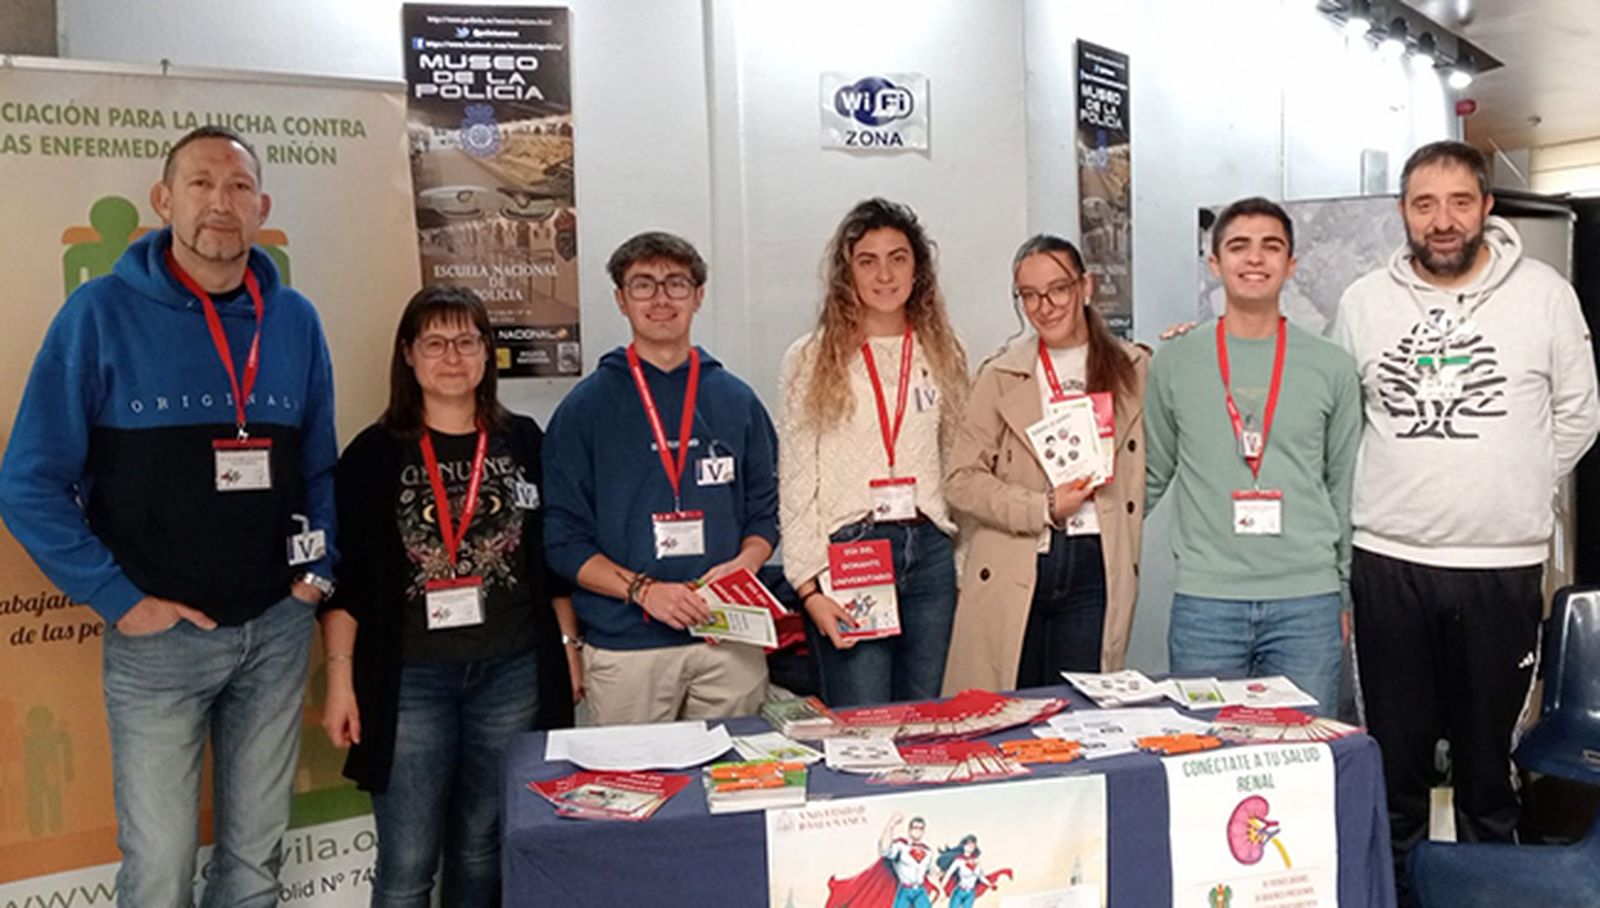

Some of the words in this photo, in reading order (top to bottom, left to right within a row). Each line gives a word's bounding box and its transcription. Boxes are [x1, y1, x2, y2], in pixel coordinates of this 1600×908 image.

[419, 54, 539, 70] MUSEO
[433, 71, 474, 84] DE
[486, 72, 526, 85] LA
[415, 84, 544, 100] POLICIA
[1081, 83, 1121, 106] MUSEO
[1085, 99, 1100, 113] DE
[1103, 104, 1117, 117] LA
[1, 99, 100, 127] CIACIÓN
[109, 107, 166, 128] PARA
[173, 111, 199, 130] LA
[283, 116, 367, 138] CONTRA
[845, 130, 904, 147] ZONA
[0, 134, 32, 155] AS
[267, 140, 337, 165] RIÑÓN
[434, 264, 489, 278] ESCUELA
[492, 263, 558, 279] NACIONAL
[401, 456, 515, 486] GENUNE
[10, 626, 36, 646] de
[42, 623, 74, 642] las
[1283, 747, 1321, 766] SALUD
[1236, 773, 1275, 793] RENAL
